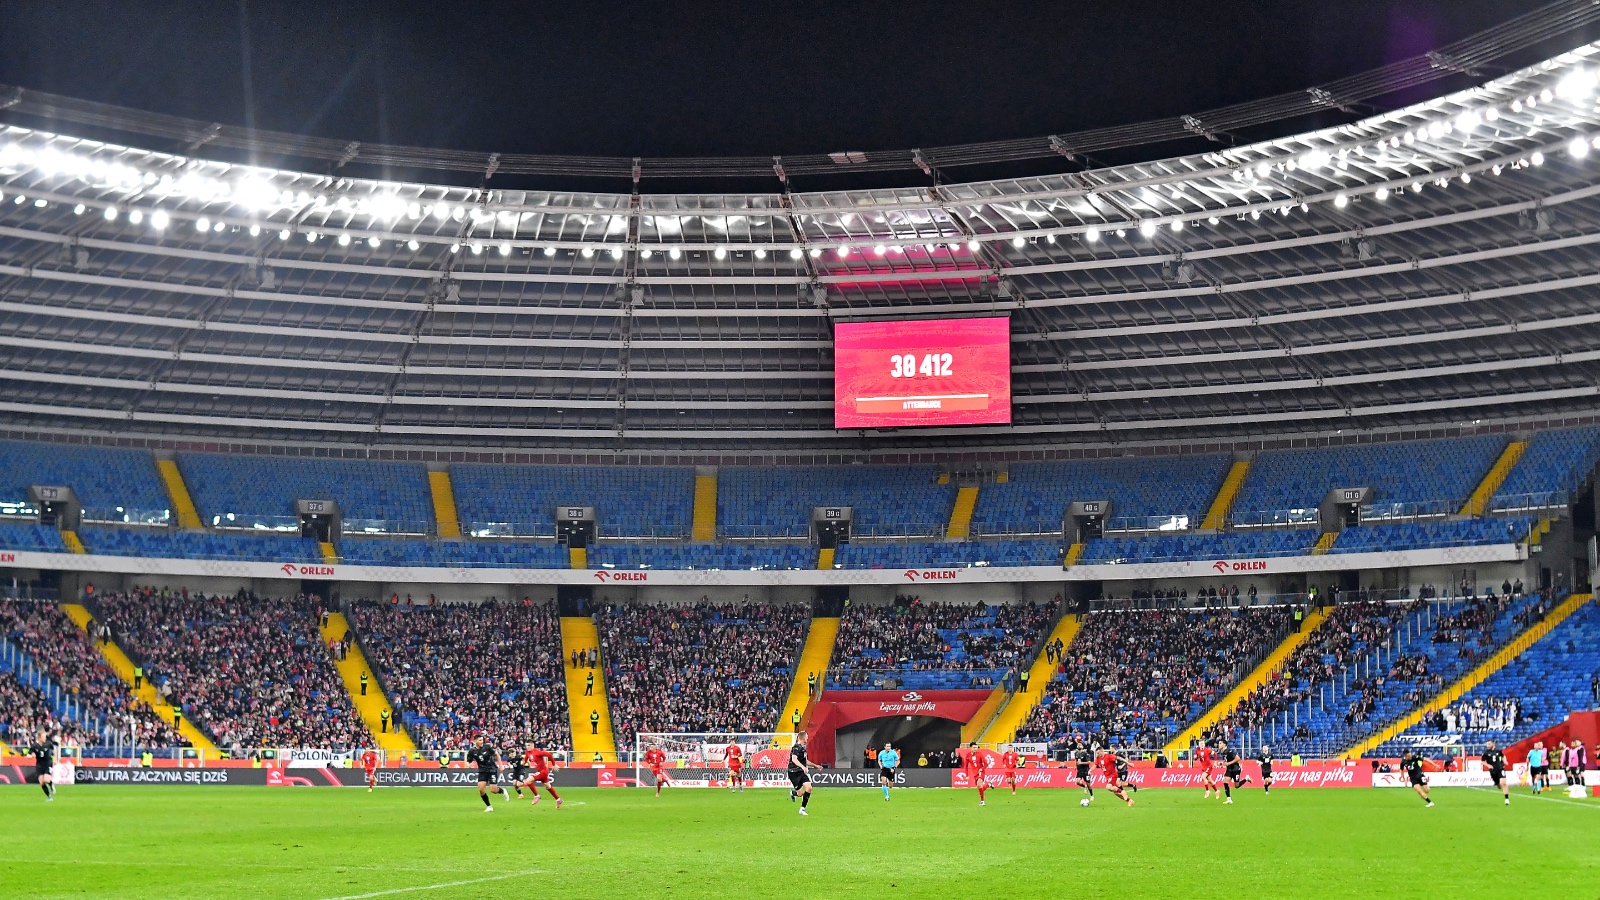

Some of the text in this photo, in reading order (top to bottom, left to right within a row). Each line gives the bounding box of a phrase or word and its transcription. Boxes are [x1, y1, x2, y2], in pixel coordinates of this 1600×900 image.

[890, 352, 953, 378] 30 412
[1344, 491, 1353, 499] 01
[1084, 504, 1093, 512] 40
[300, 566, 334, 575] ORLEN
[1232, 561, 1266, 571] ORLEN
[613, 572, 647, 581] ORLEN
[922, 571, 956, 580] ORLEN
[880, 702, 901, 714] Łączy
[915, 702, 936, 714] piłka
[95, 770, 130, 781] JUTRA
[132, 770, 183, 782] ZACZYNA
[184, 771, 201, 785] SIĘ
[203, 769, 228, 783] DZIŚ
[411, 772, 450, 783] JUTRA
[856, 773, 875, 786] SIĘ
[1024, 770, 1052, 787] piłka
[1160, 771, 1191, 786] Łączy
[1299, 771, 1321, 782] nas
[1320, 767, 1354, 787] piłka
